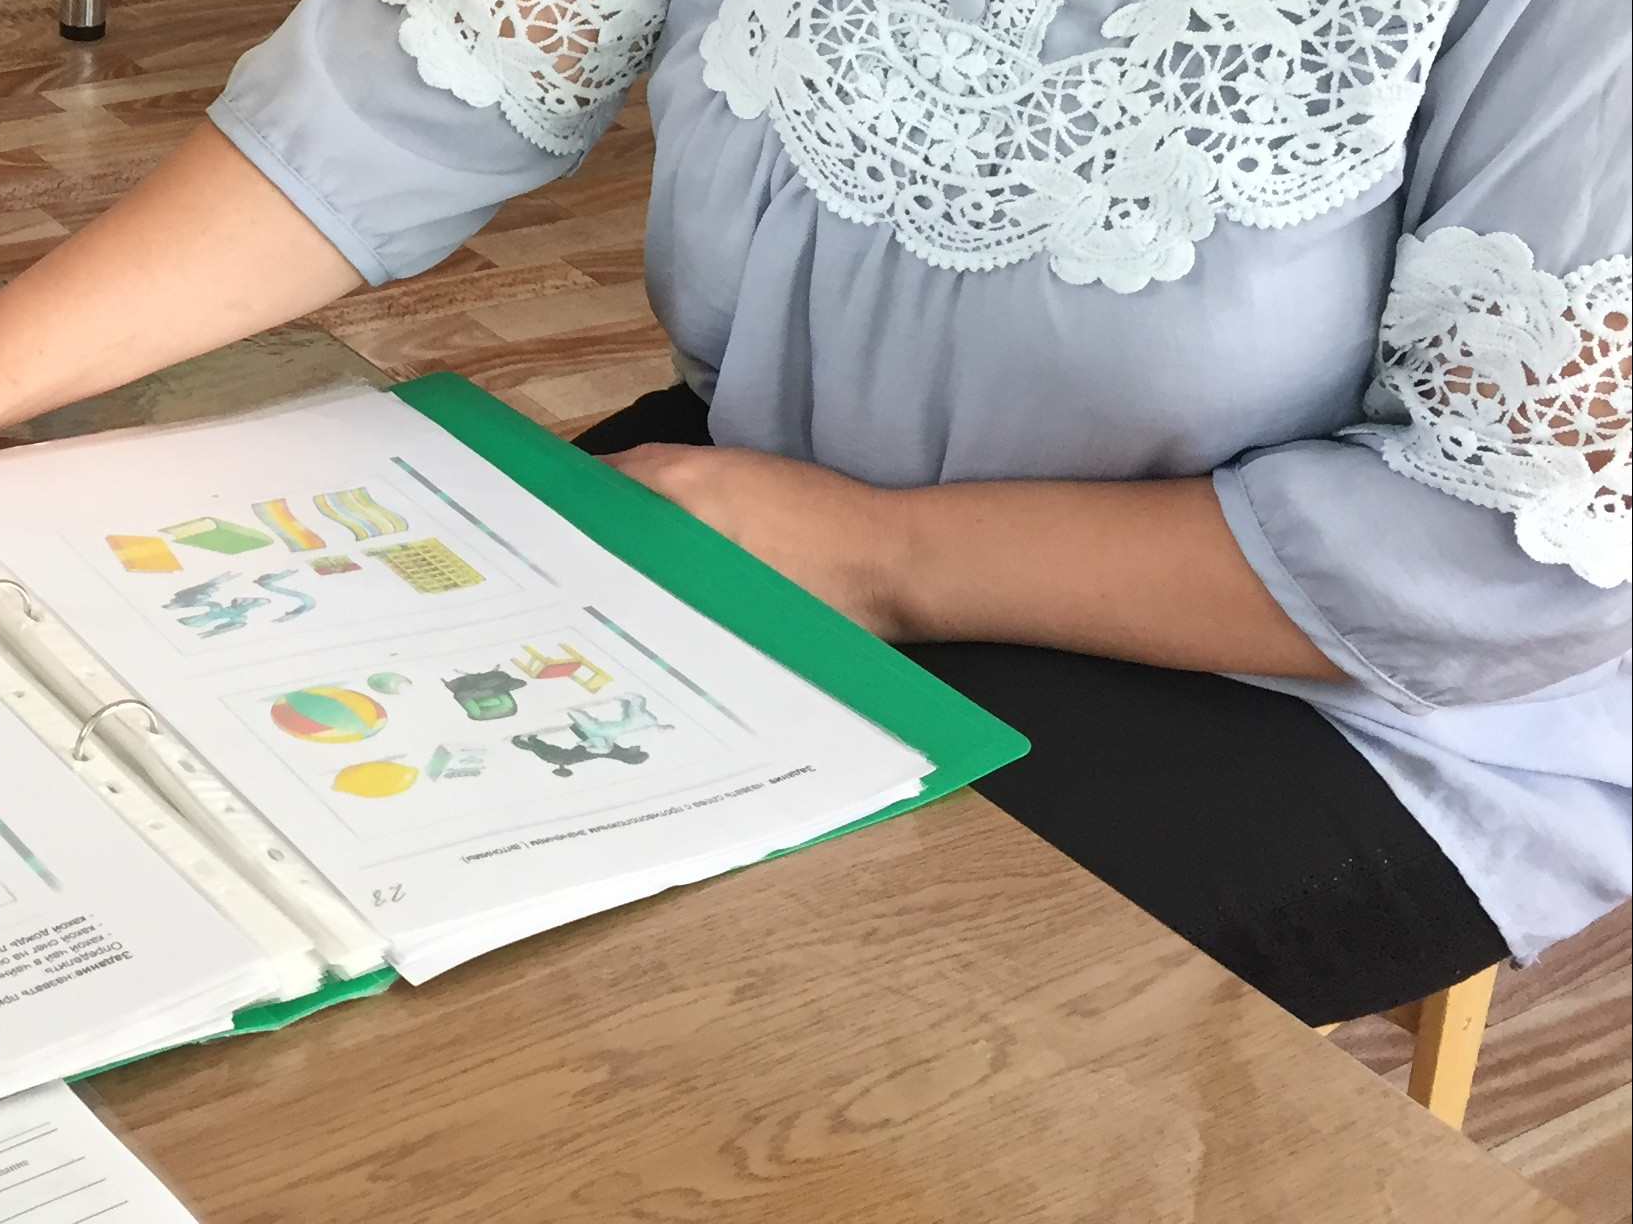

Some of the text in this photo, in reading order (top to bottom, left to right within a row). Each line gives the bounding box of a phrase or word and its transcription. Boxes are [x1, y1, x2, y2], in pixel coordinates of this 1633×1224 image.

[724, 782, 765, 799] назвать
[692, 794, 725, 809] слова
[588, 805, 685, 835] противоположным
[529, 829, 588, 847] значением
[372, 882, 407, 907] 28
[51, 915, 87, 934] какой
[9, 927, 50, 948] дождь
[60, 924, 96, 944] какой
[32, 938, 60, 954] снег
[69, 934, 105, 954] какой
[11, 950, 30, 962] на
[33, 958, 43, 967] в
[44, 949, 69, 963] чай
